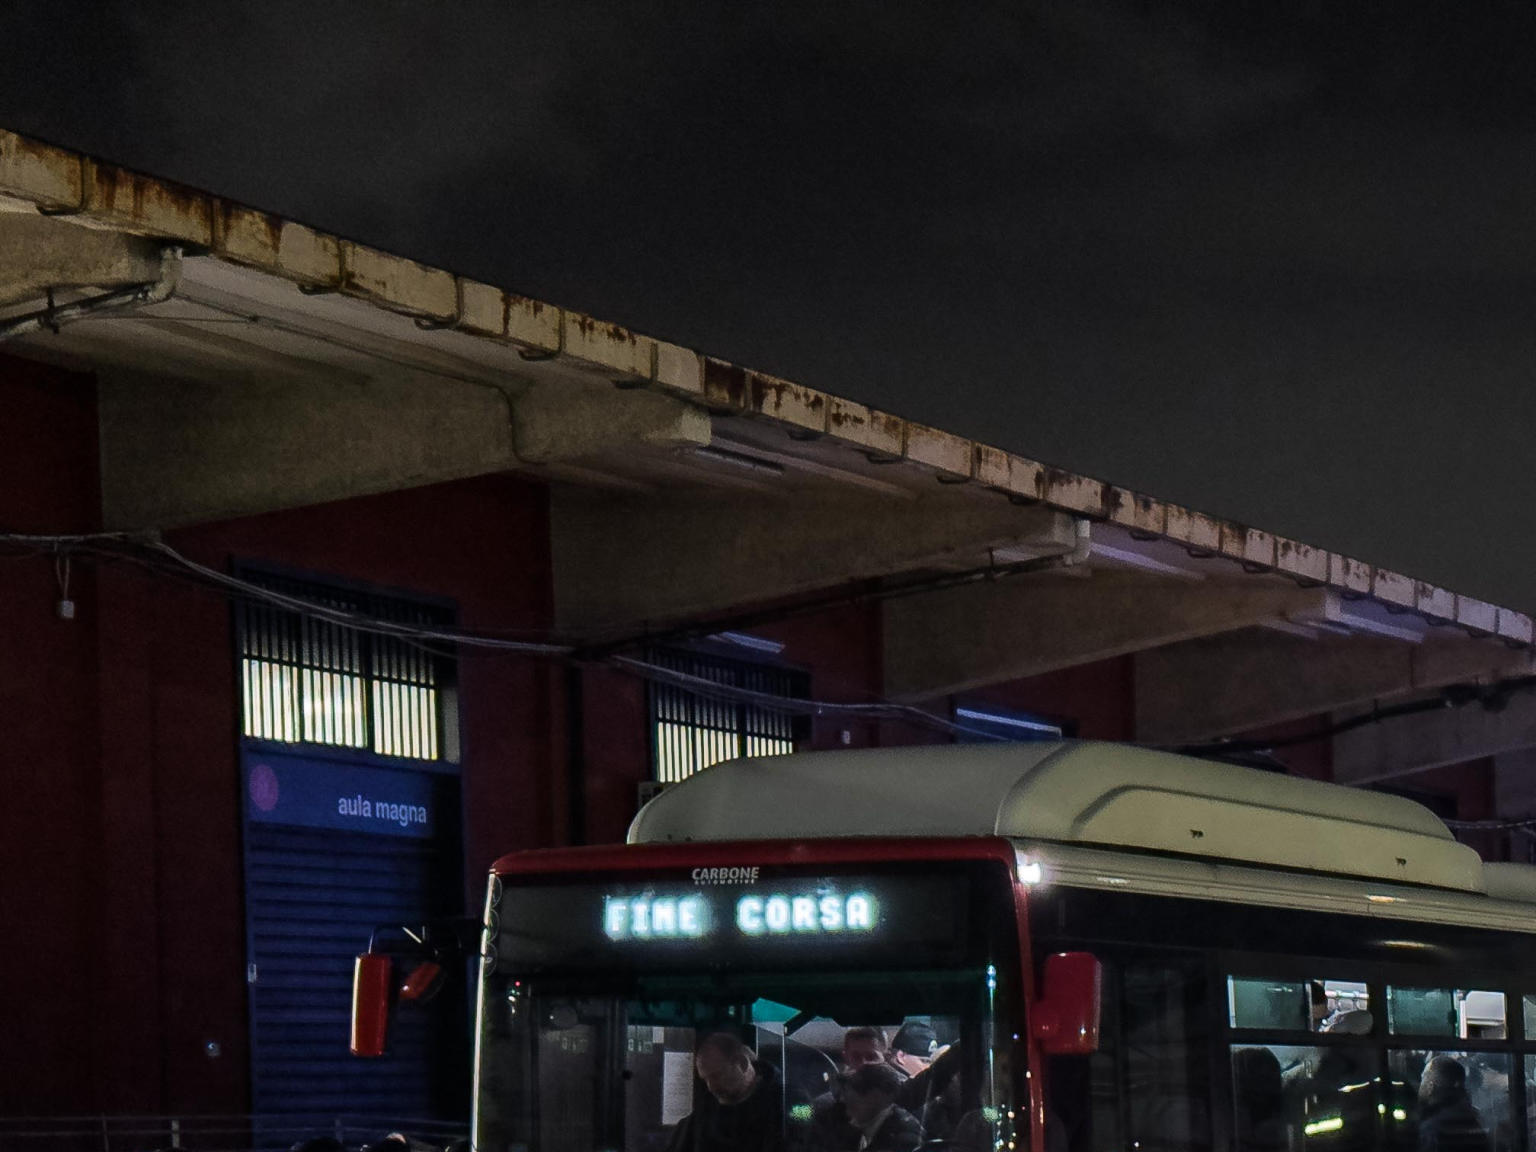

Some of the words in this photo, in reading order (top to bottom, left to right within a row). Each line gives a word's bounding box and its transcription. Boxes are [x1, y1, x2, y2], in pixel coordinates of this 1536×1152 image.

[338, 795, 372, 817] aula
[376, 801, 427, 827] magna
[692, 867, 760, 881] CARBONE
[737, 895, 870, 932] CORSA
